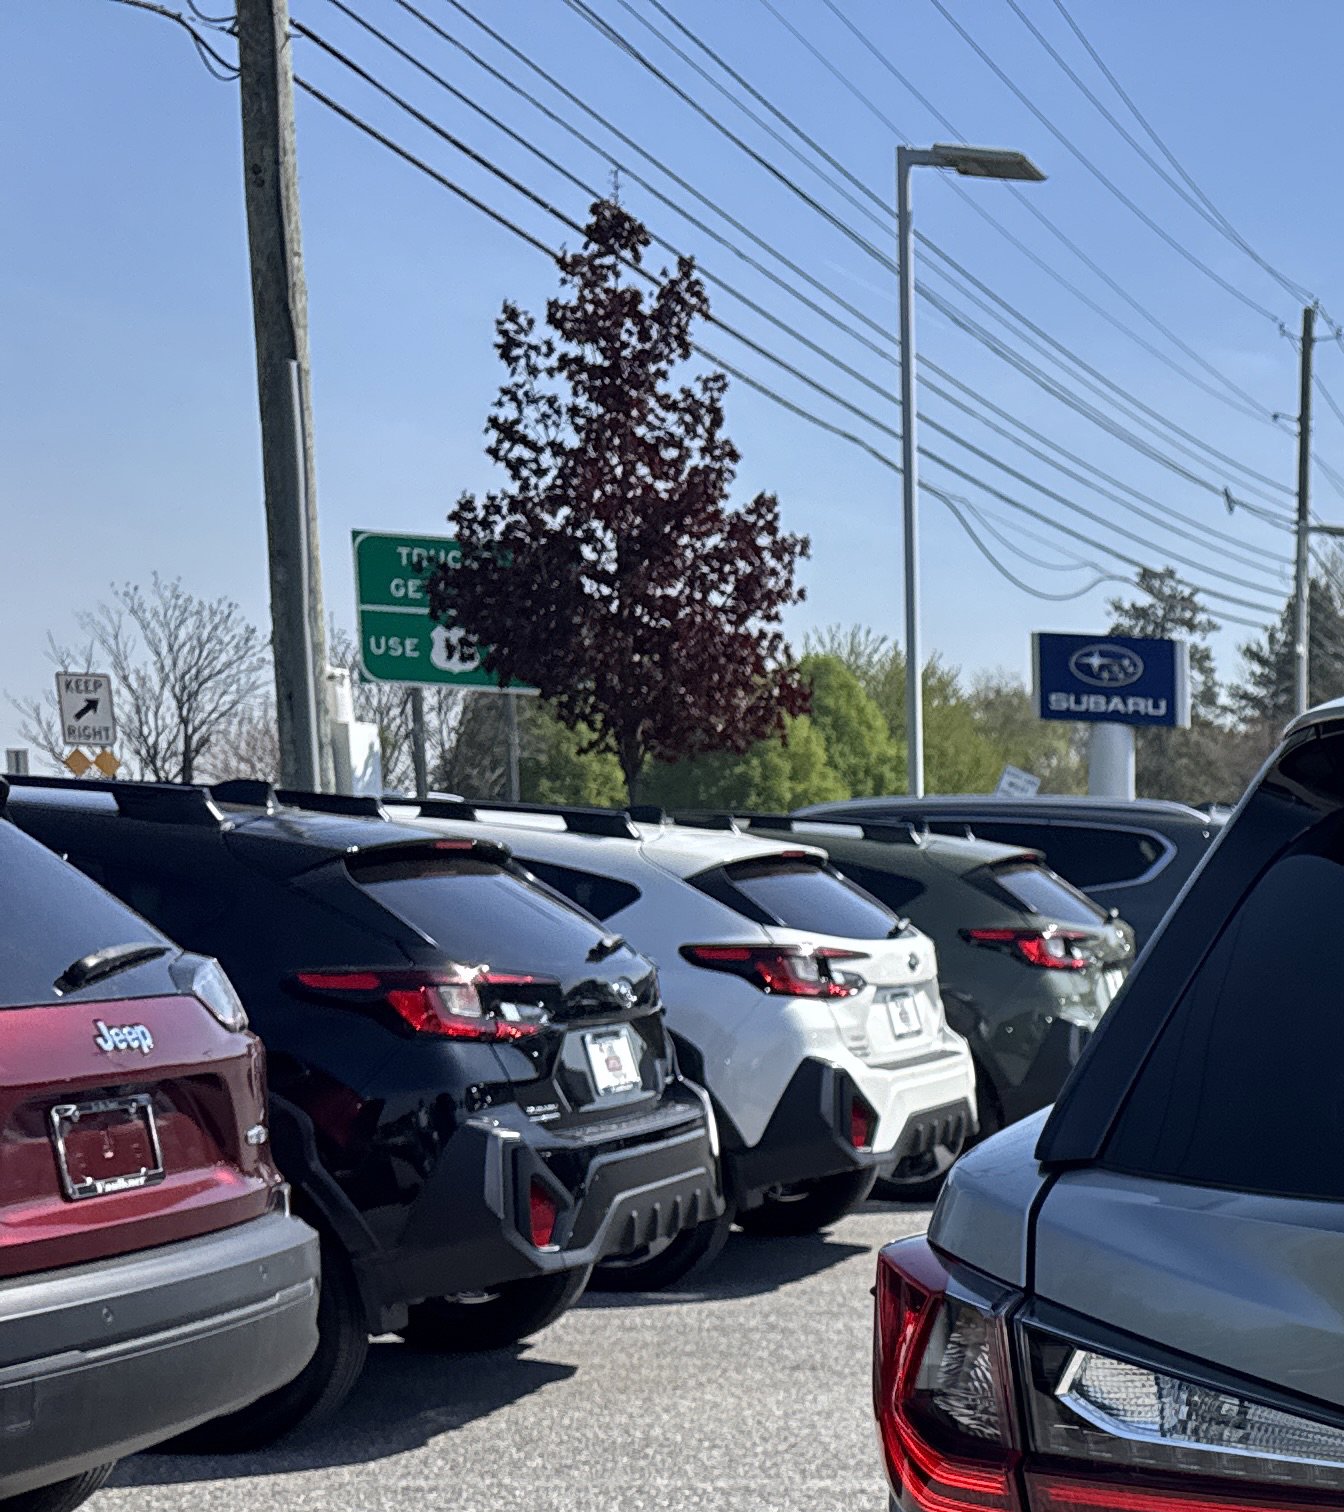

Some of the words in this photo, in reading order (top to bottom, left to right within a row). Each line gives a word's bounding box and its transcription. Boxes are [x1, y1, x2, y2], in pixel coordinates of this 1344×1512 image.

[369, 634, 420, 658] USE
[64, 679, 103, 694] KEEP
[1047, 691, 1168, 717] SUBARU
[67, 725, 110, 741] RIGHT
[92, 1019, 155, 1056] Jeep
